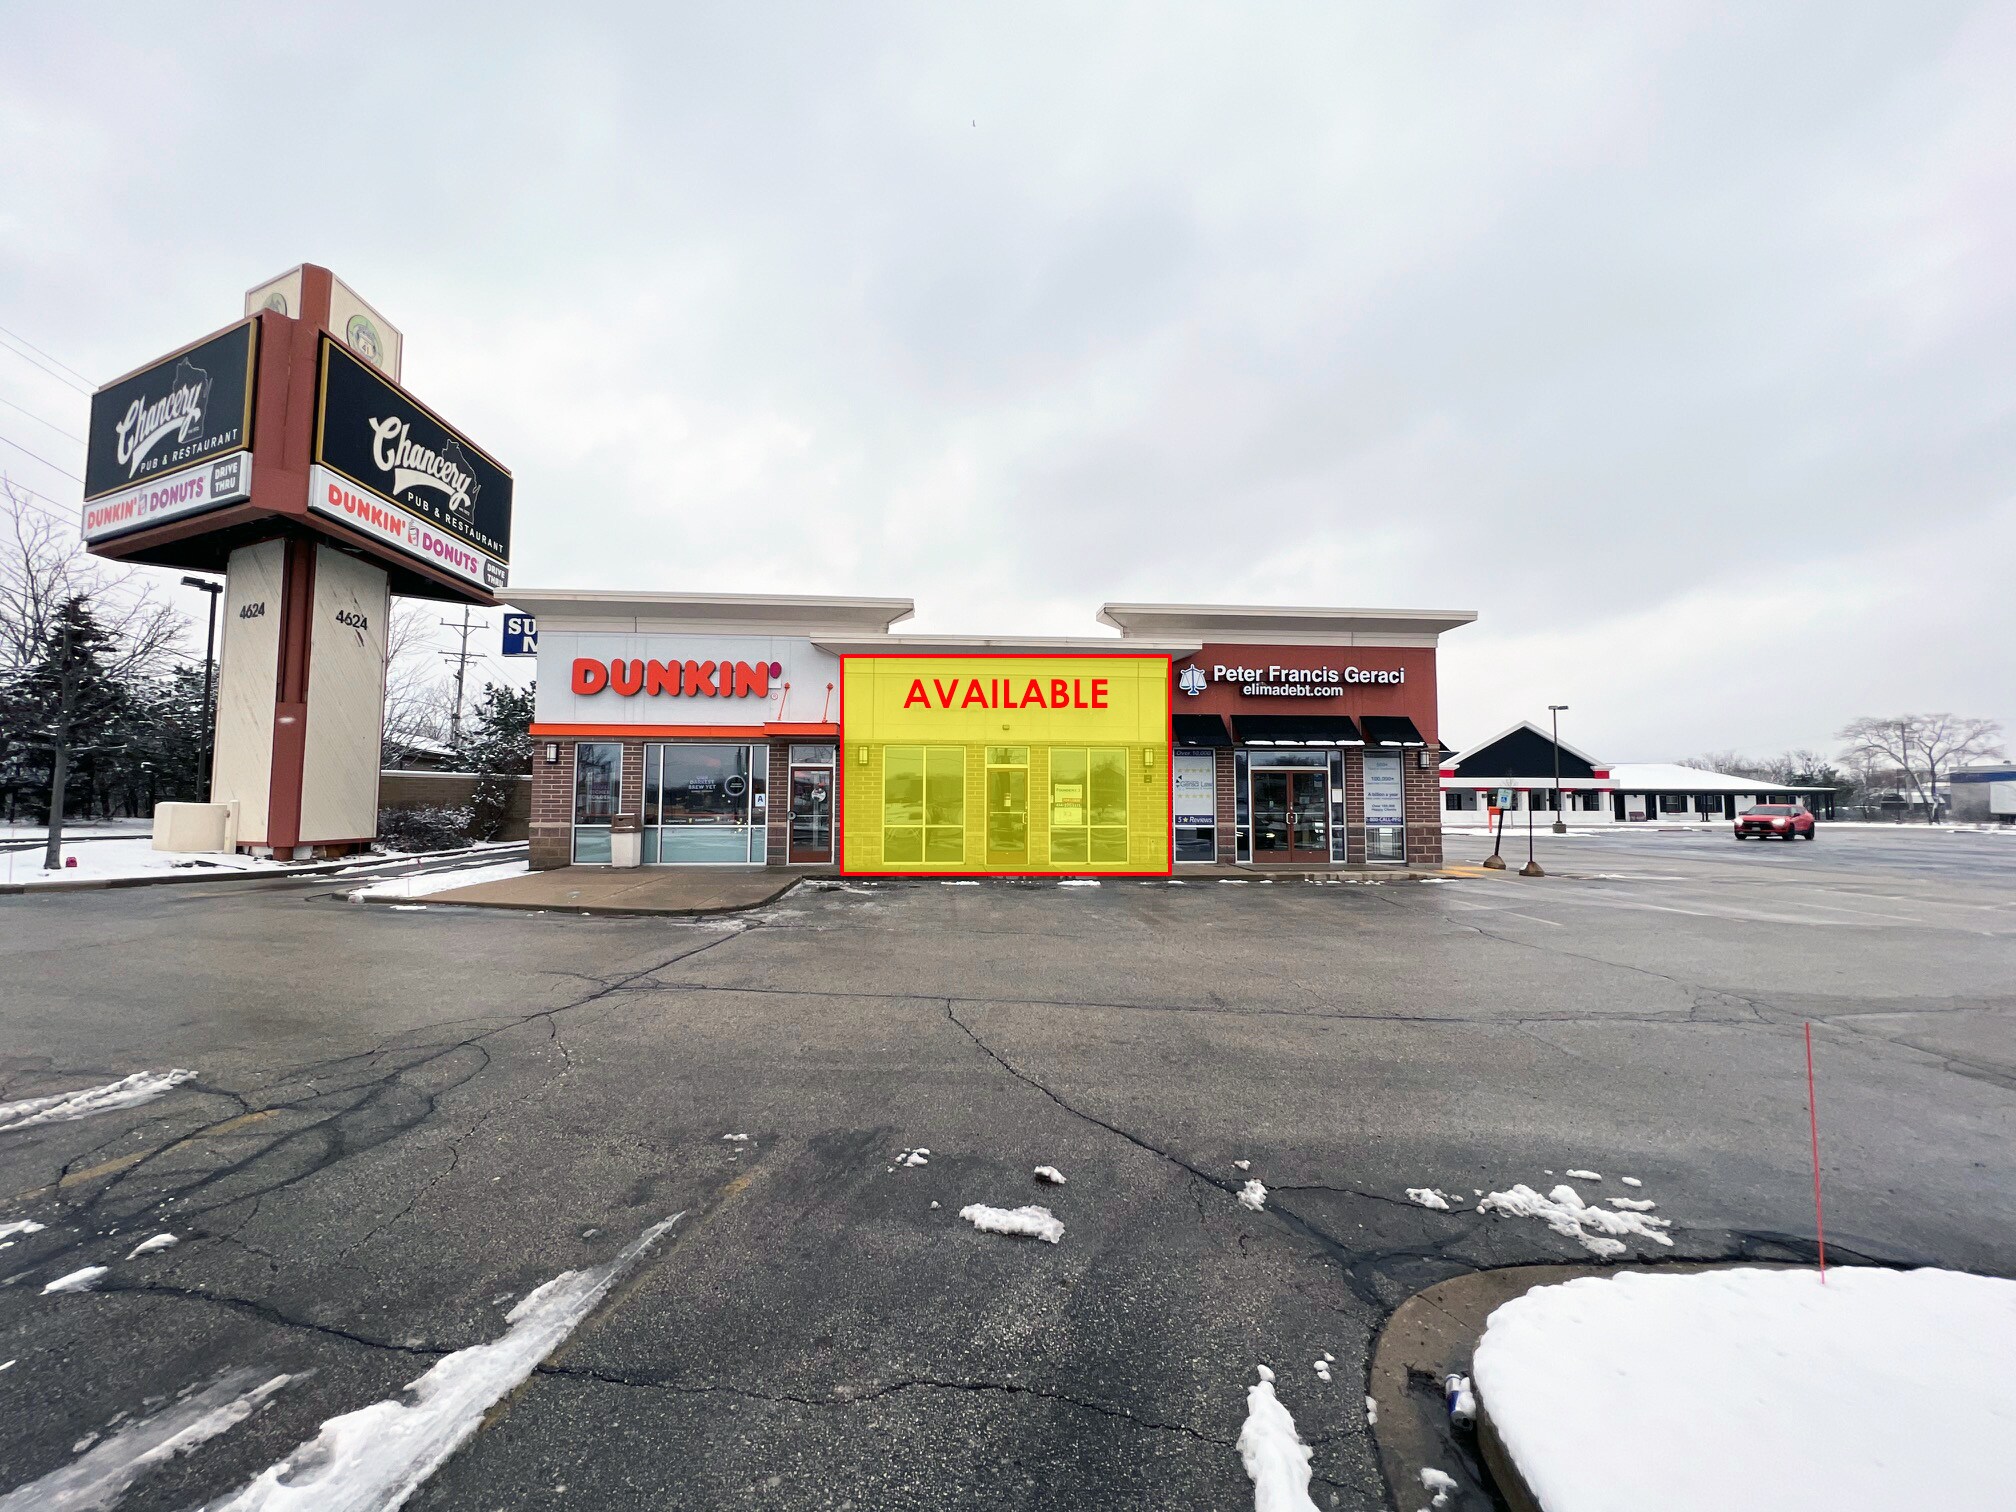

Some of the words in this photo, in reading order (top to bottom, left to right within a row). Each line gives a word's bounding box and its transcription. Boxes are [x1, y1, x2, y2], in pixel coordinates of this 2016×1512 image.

[116, 383, 203, 470] Chancery
[140, 457, 159, 474] PUB
[161, 453, 169, 466] &
[171, 428, 239, 463] RESTAURANT
[214, 461, 239, 480] DRIVE
[368, 415, 473, 512] Chancery
[214, 476, 237, 493] THRU
[87, 497, 137, 531] DUNKIN'
[149, 476, 205, 513] DONUTS
[327, 483, 406, 538] DUNKIN'
[422, 532, 478, 575] DONUTS
[407, 491, 430, 512] PUB
[433, 506, 441, 519] &
[445, 513, 505, 554] RESTAURANT
[486, 562, 506, 580] DRIVE
[486, 574, 505, 588] THRU
[239, 602, 266, 619] 4624
[335, 609, 369, 632] 4624
[571, 657, 783, 700] DUNKIN'
[1213, 665, 1264, 683] Peter
[1268, 665, 1340, 684] Francis
[1344, 666, 1406, 685] Geraci
[1242, 683, 1344, 697] elimadebt.com
[757, 795, 764, 803] A
[1177, 816, 1183, 824] 5
[1189, 816, 1213, 824] Reviews
